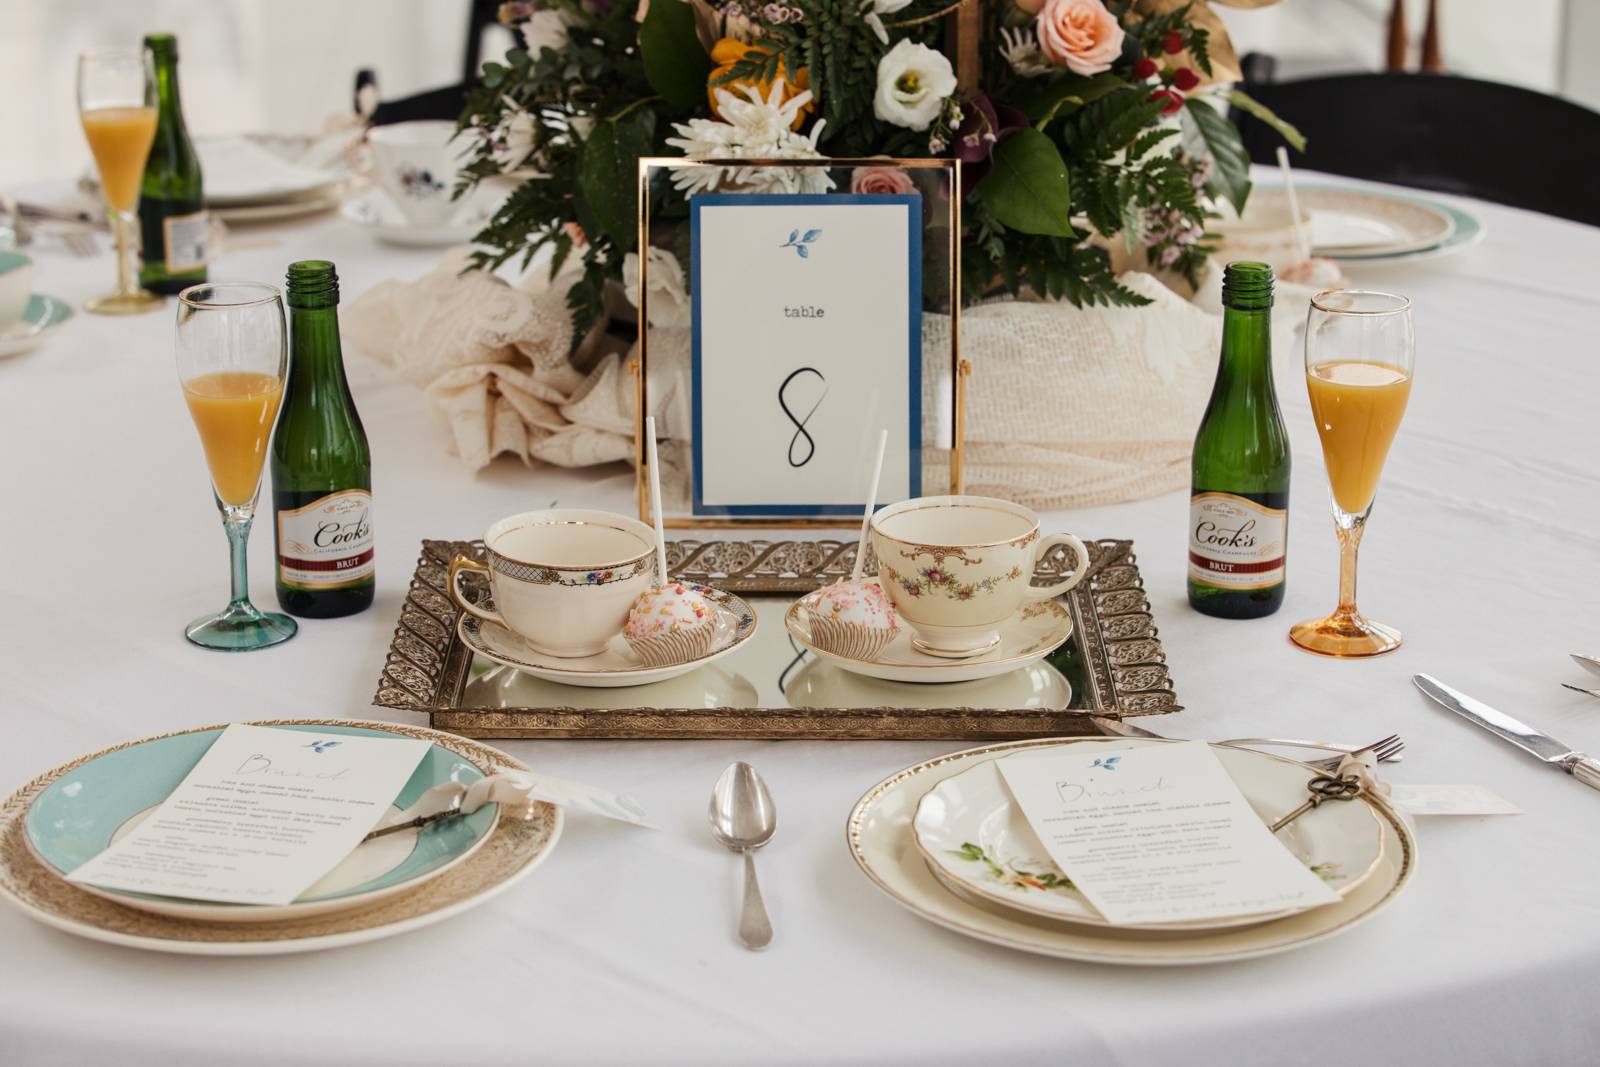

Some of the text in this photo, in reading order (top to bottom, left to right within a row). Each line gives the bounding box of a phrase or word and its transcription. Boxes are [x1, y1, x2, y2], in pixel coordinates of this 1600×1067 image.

[784, 305, 825, 318] table
[778, 367, 830, 468] 8
[314, 511, 369, 548] Cook's
[1195, 516, 1257, 548] Cook's
[336, 557, 360, 569] BRUT
[1209, 561, 1234, 572] BRUT
